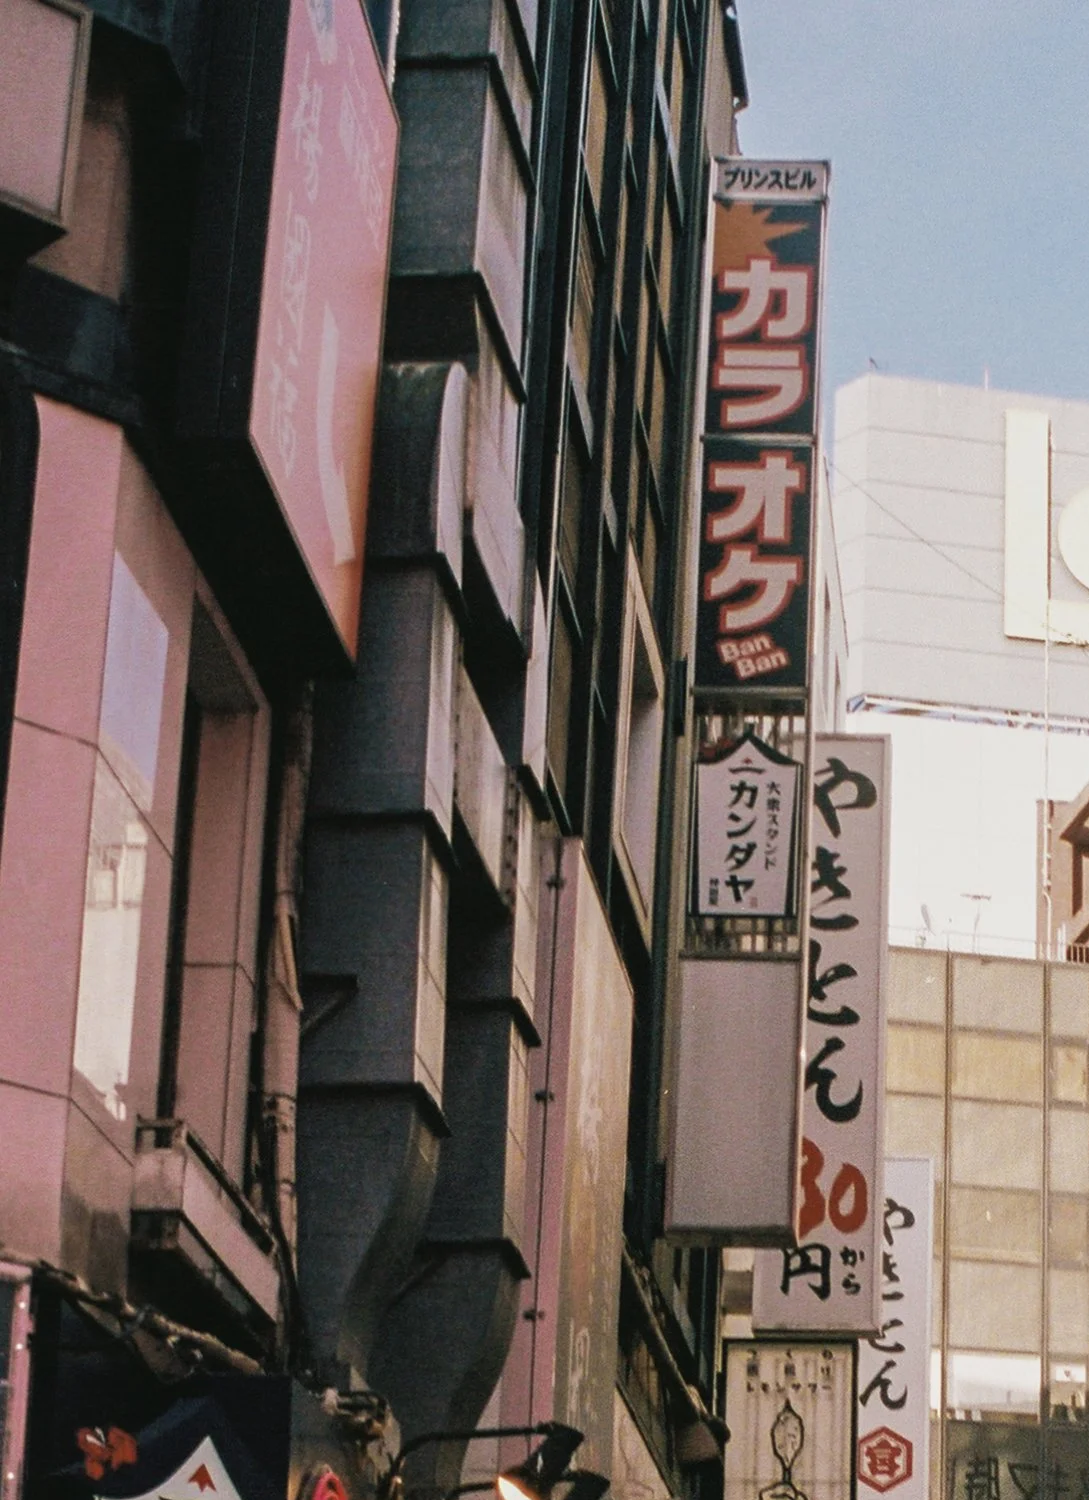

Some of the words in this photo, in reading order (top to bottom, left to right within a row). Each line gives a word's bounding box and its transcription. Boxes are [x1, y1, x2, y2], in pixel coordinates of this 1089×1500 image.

[724, 167, 817, 190] プリンスビル
[708, 258, 809, 632] カラオケ
[719, 635, 771, 663] Ban
[736, 650, 787, 679] Ban
[725, 780, 758, 902] カンダヤ
[806, 757, 877, 1122] やきとん
[780, 1243, 831, 1302] 円
[840, 1245, 865, 1296] から
